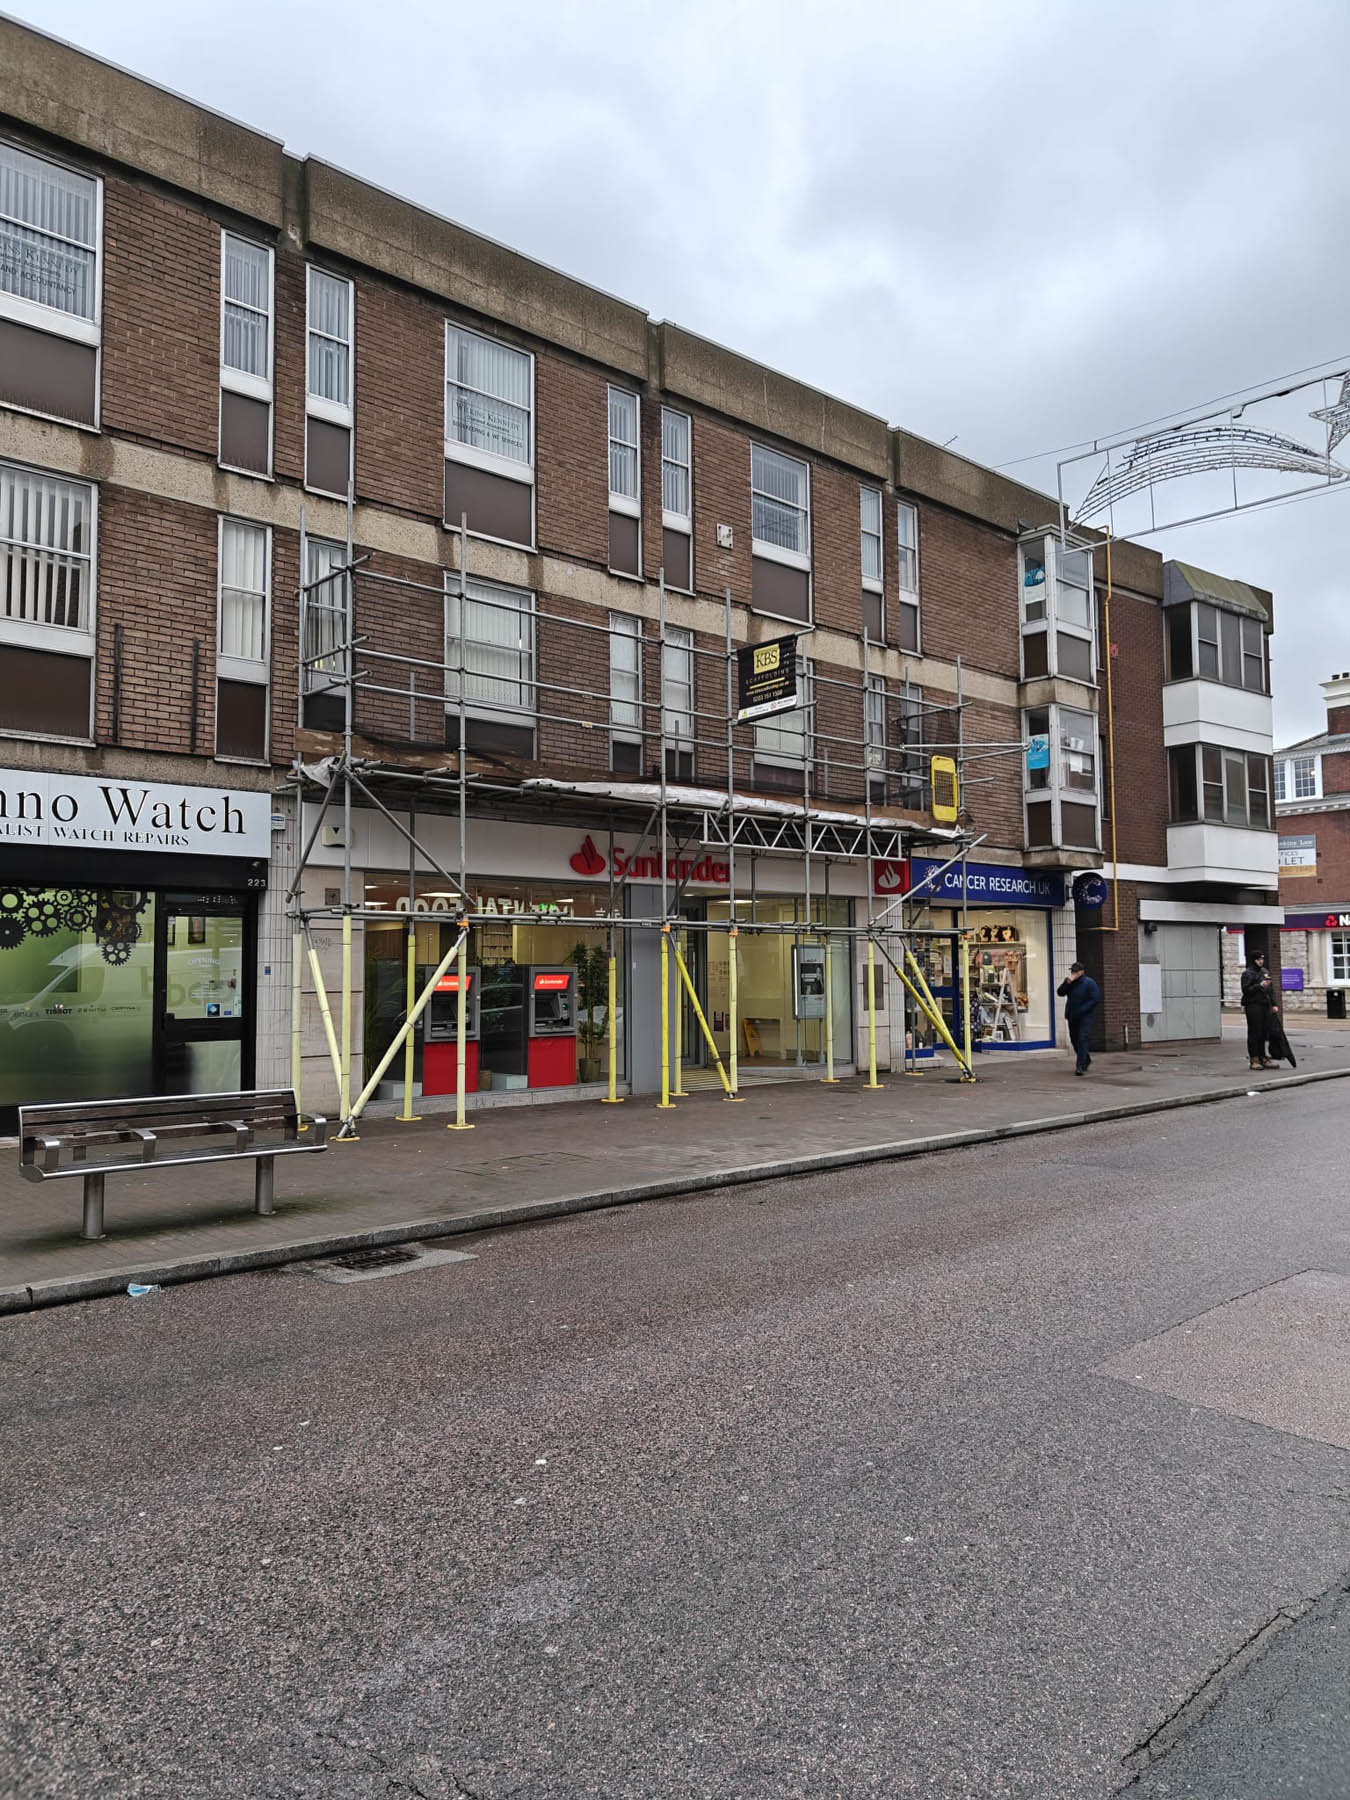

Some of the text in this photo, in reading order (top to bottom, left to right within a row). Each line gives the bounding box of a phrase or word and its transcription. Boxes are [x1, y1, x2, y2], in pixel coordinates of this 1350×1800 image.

[1, 263, 76, 294] AND ACCOUNTANCY
[756, 650, 778, 668] KBS
[97, 785, 247, 835] Watch
[53, 826, 114, 842] WATCH
[123, 830, 189, 847] REPAIRS
[1285, 856, 1305, 866] LET
[247, 877, 266, 888] 223
[989, 877, 1037, 895] RESEARCH
